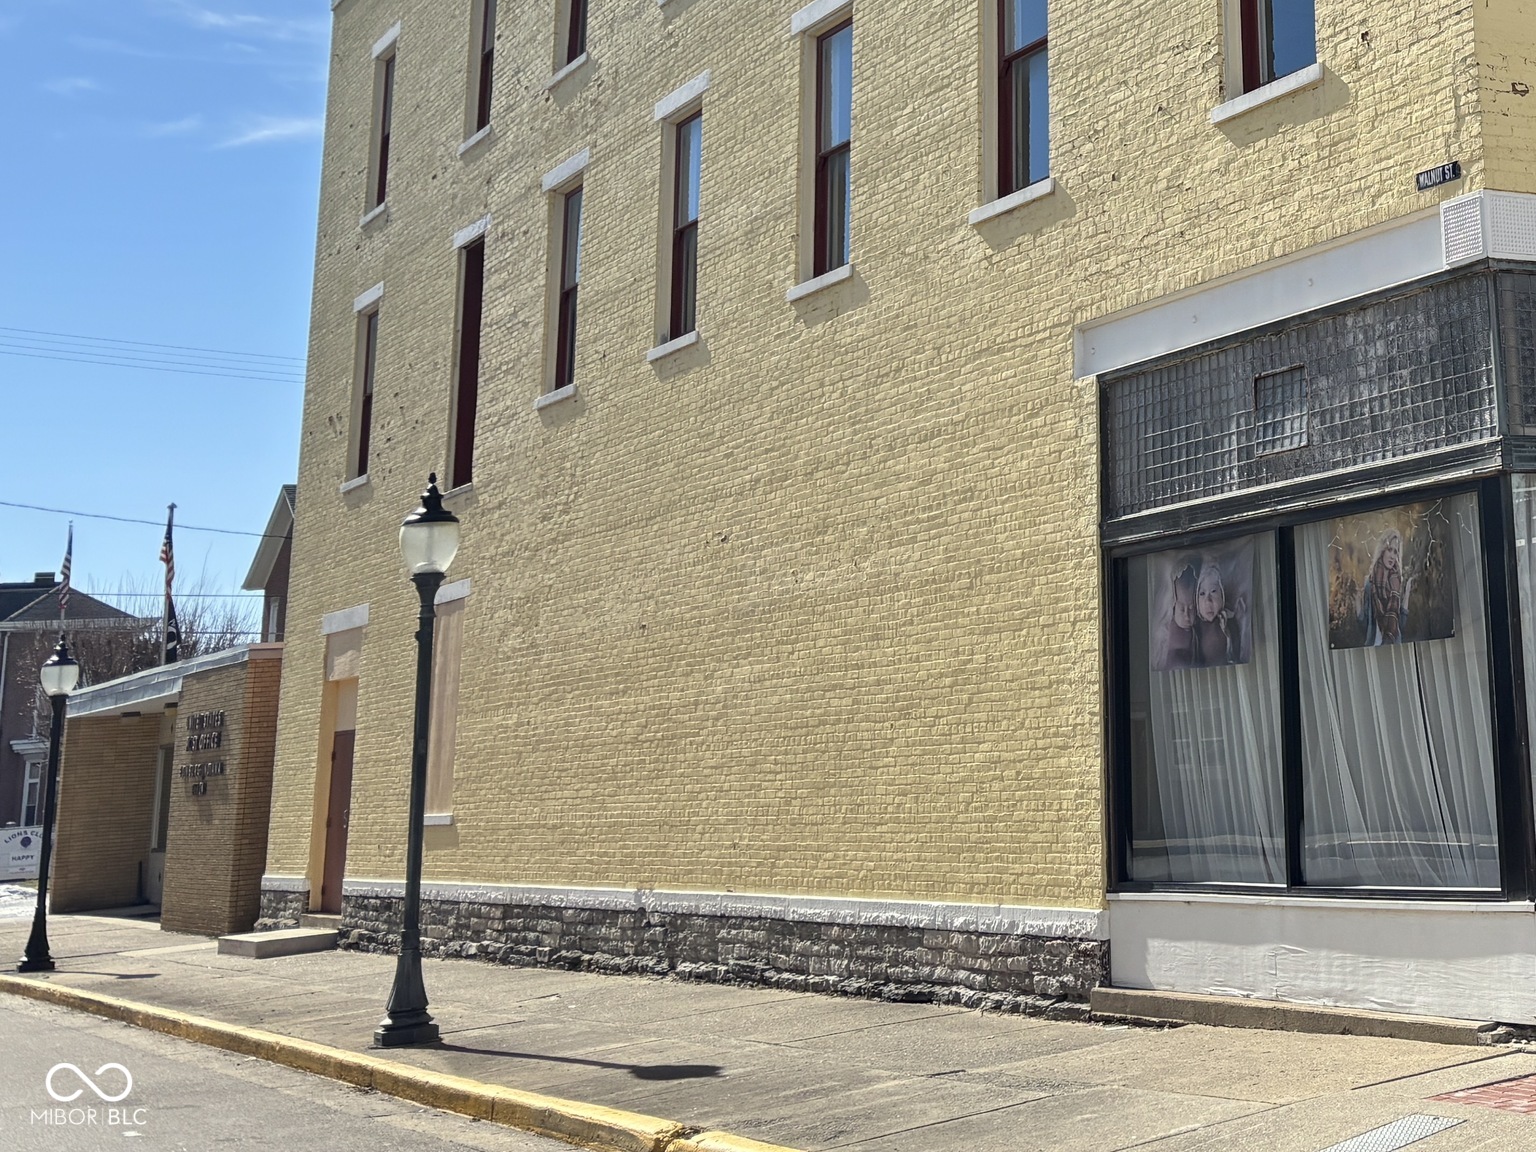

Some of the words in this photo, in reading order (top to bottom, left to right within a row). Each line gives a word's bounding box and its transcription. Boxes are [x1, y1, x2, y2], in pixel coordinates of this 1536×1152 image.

[1419, 167, 1443, 188] WALNUT
[1444, 164, 1456, 180] ST.
[4, 830, 28, 844] LIONS
[12, 854, 34, 862] HAPPY
